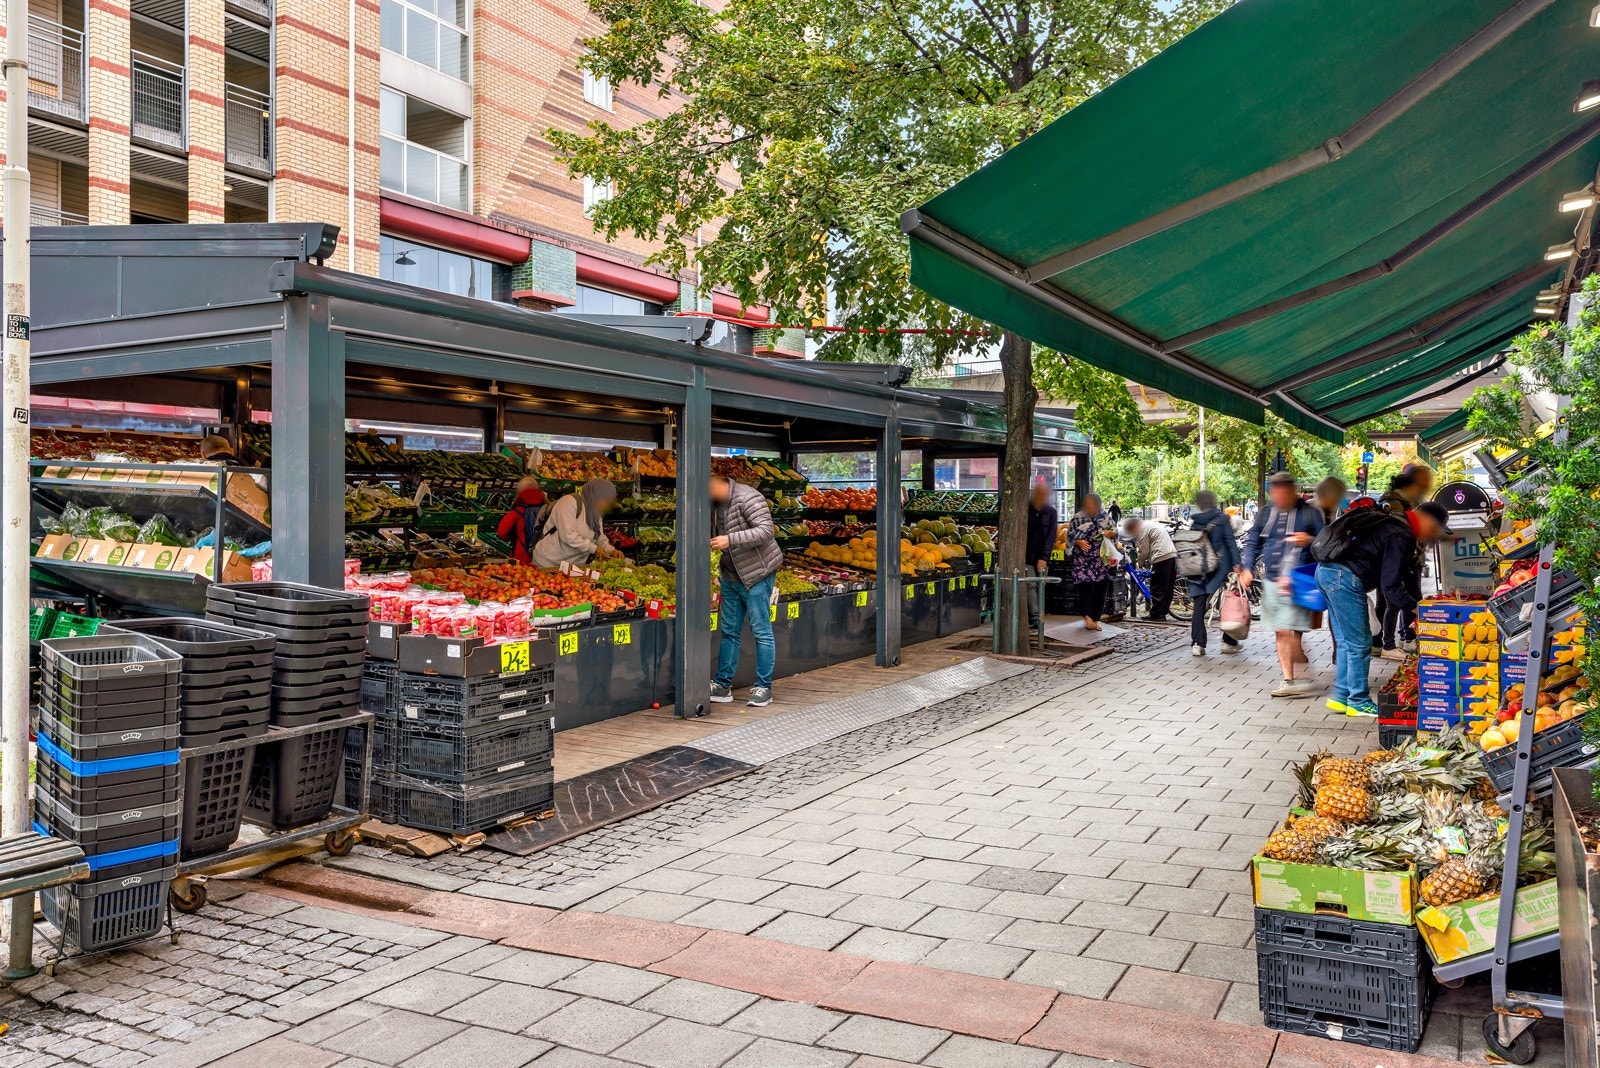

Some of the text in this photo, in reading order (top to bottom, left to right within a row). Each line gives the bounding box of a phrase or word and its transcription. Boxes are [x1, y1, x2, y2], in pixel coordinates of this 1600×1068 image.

[124, 665, 144, 673] MENY
[122, 732, 142, 741] MENY
[122, 811, 142, 820] MENY
[122, 877, 142, 886] MENY
[1368, 896, 1399, 905] PINEAPPLE
